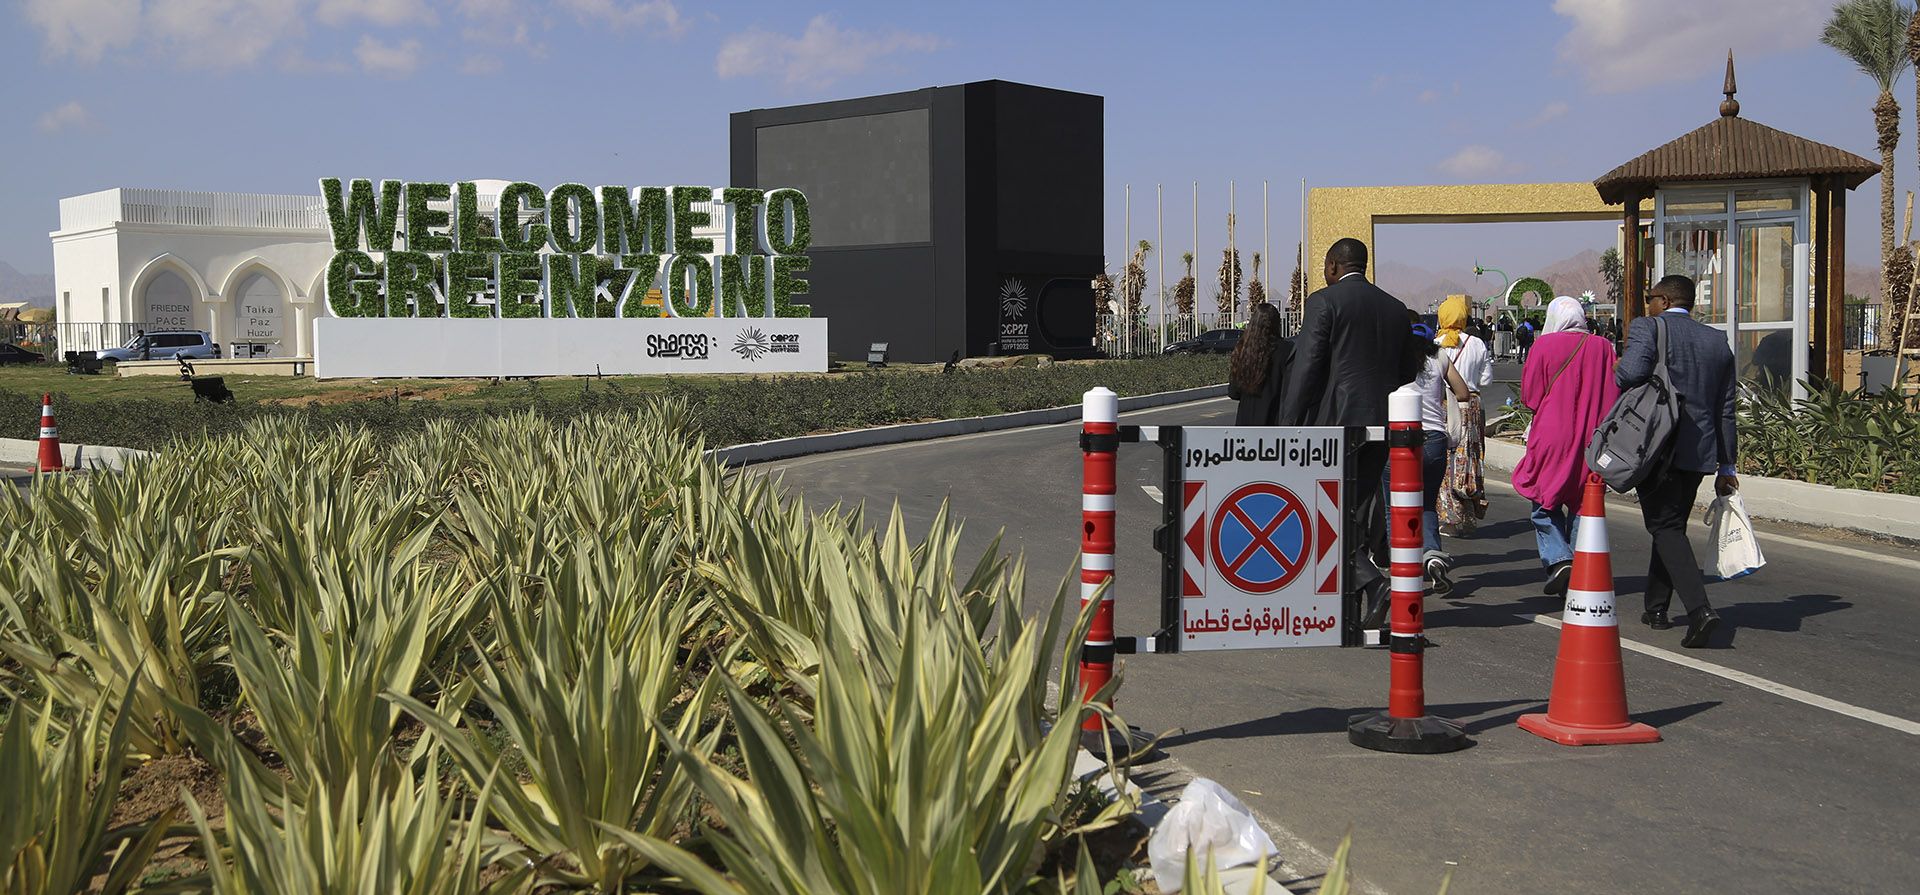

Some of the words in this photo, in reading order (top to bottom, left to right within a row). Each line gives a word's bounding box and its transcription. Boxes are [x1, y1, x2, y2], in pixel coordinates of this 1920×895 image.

[318, 177, 714, 255] WELCOME
[714, 186, 812, 256] TO
[324, 250, 598, 318] GREEN
[616, 253, 812, 318] ZONE
[150, 304, 190, 313] FRIEDEN
[246, 305, 274, 314] Taika
[156, 316, 187, 326] PACE
[250, 318, 270, 326] Paz
[247, 329, 274, 338] Huzur
[770, 334, 799, 342] COP27
[1185, 438, 1234, 468] للمرور
[1235, 438, 1286, 467] العامة
[1589, 600, 1612, 617] جنوب
[1232, 606, 1290, 636] الوقوف
[1292, 606, 1336, 636] ممنوع
